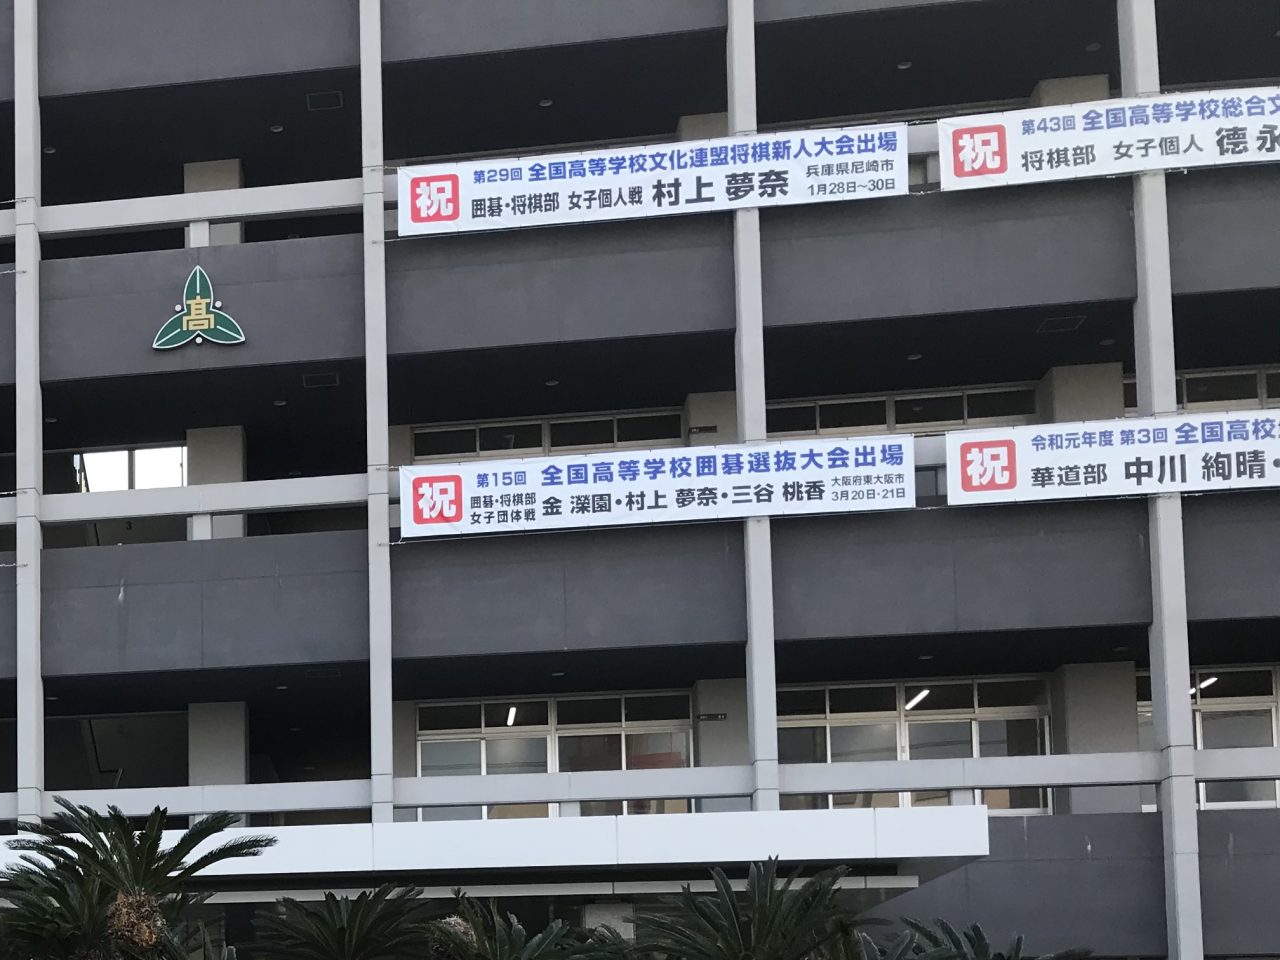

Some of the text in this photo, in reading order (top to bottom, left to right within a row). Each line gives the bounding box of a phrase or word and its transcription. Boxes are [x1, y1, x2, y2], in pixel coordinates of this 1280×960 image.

[1021, 115, 1076, 135] 第43回
[473, 132, 898, 184] 第29回 全国高等学校文化連盟将棋新人大会出場
[806, 159, 894, 178] 兵庫県尼崎市
[958, 131, 1002, 171] 祝
[1021, 144, 1097, 172] 将棋部
[1113, 133, 1204, 161] 女子個人
[416, 181, 454, 217] 祝
[471, 170, 789, 219] 囲碁・将棋部 女子個人戦 村上 夢奈
[1031, 418, 1280, 451] 令和元年度 第3回 全国高校
[476, 444, 904, 488] 第15回 全国高等学校囲碁選抜大会出場
[831, 473, 905, 487] 大阪府東大阪市
[966, 447, 1010, 486] 祝
[1031, 463, 1108, 488] 華道部
[1124, 454, 1187, 486] 中川
[417, 481, 456, 519] 祝
[470, 492, 537, 509] 囲碁・将棋部
[542, 496, 562, 516] 金
[782, 480, 826, 502] 桃香
[470, 508, 536, 525] 女子団体戦
